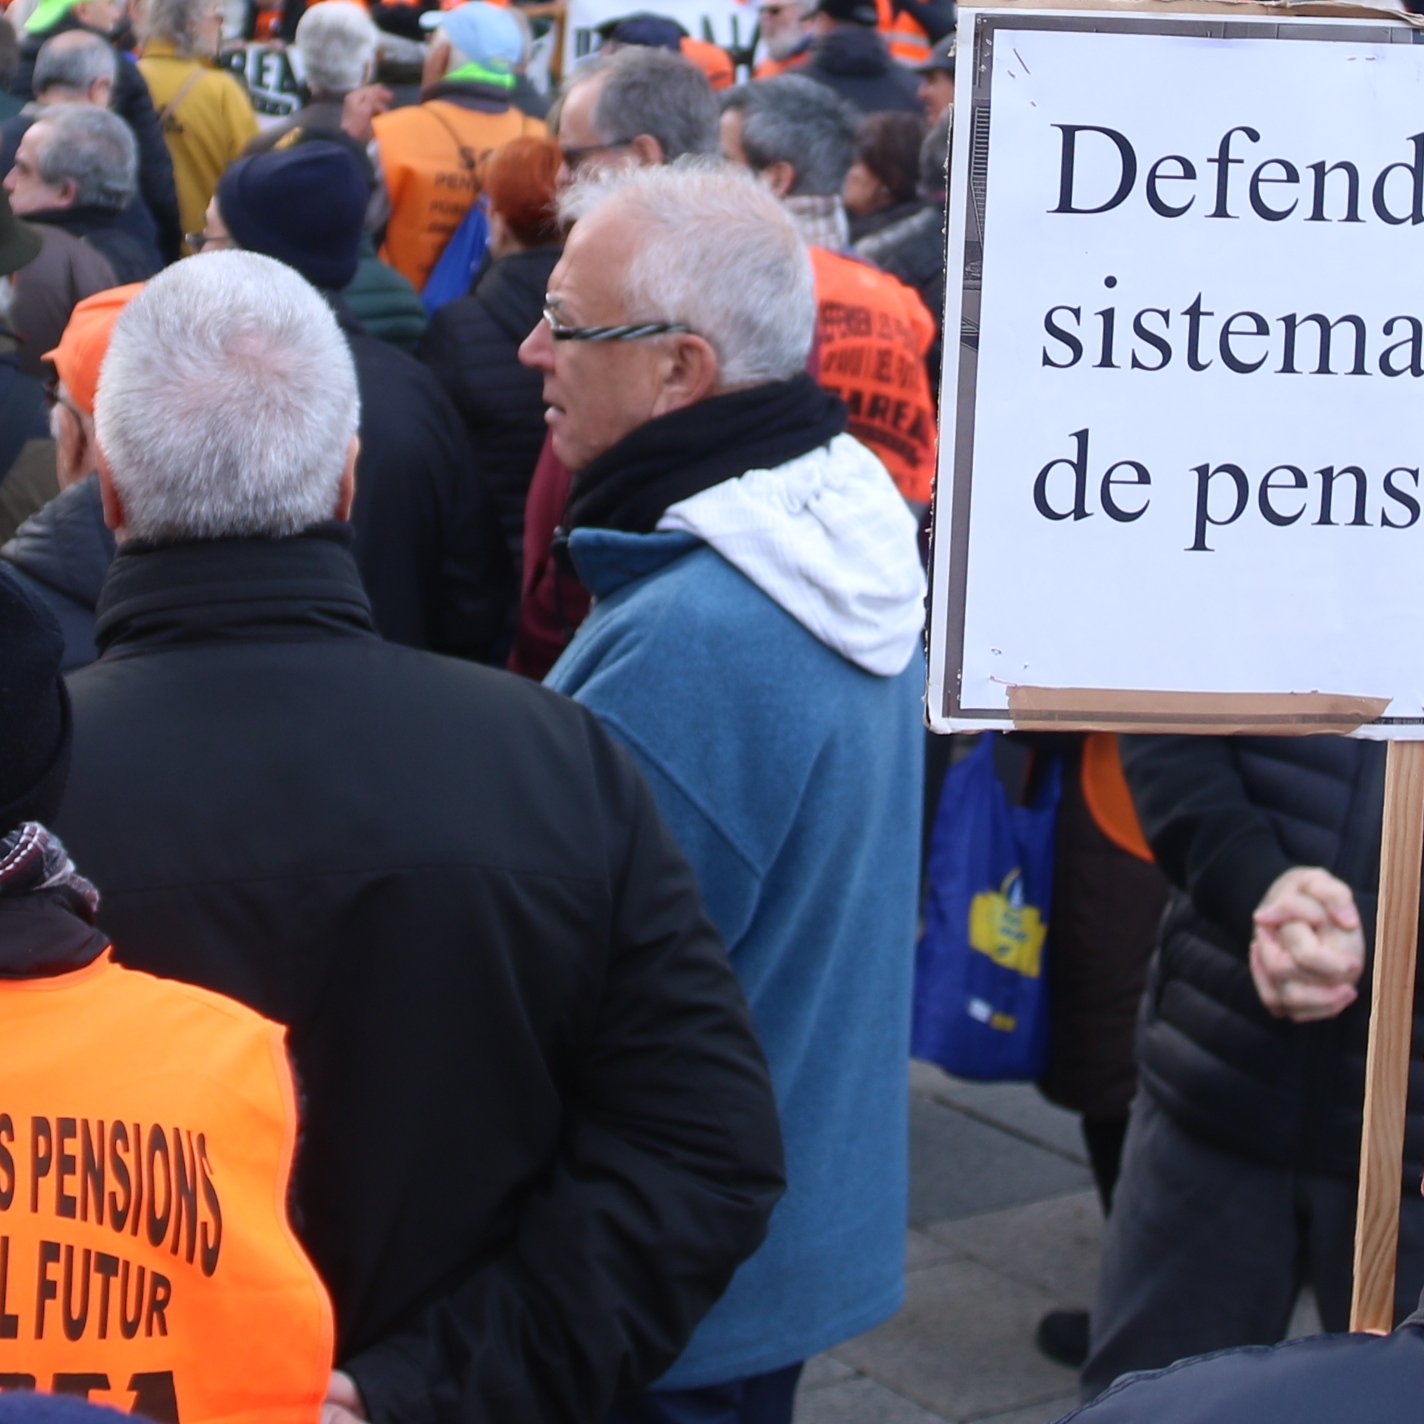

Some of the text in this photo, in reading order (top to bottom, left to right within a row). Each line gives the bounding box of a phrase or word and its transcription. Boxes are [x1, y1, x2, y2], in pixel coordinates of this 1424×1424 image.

[1032, 427, 1153, 523] de
[29, 1115, 224, 1279] PENSIONS
[34, 1239, 173, 1343] FUTUR
